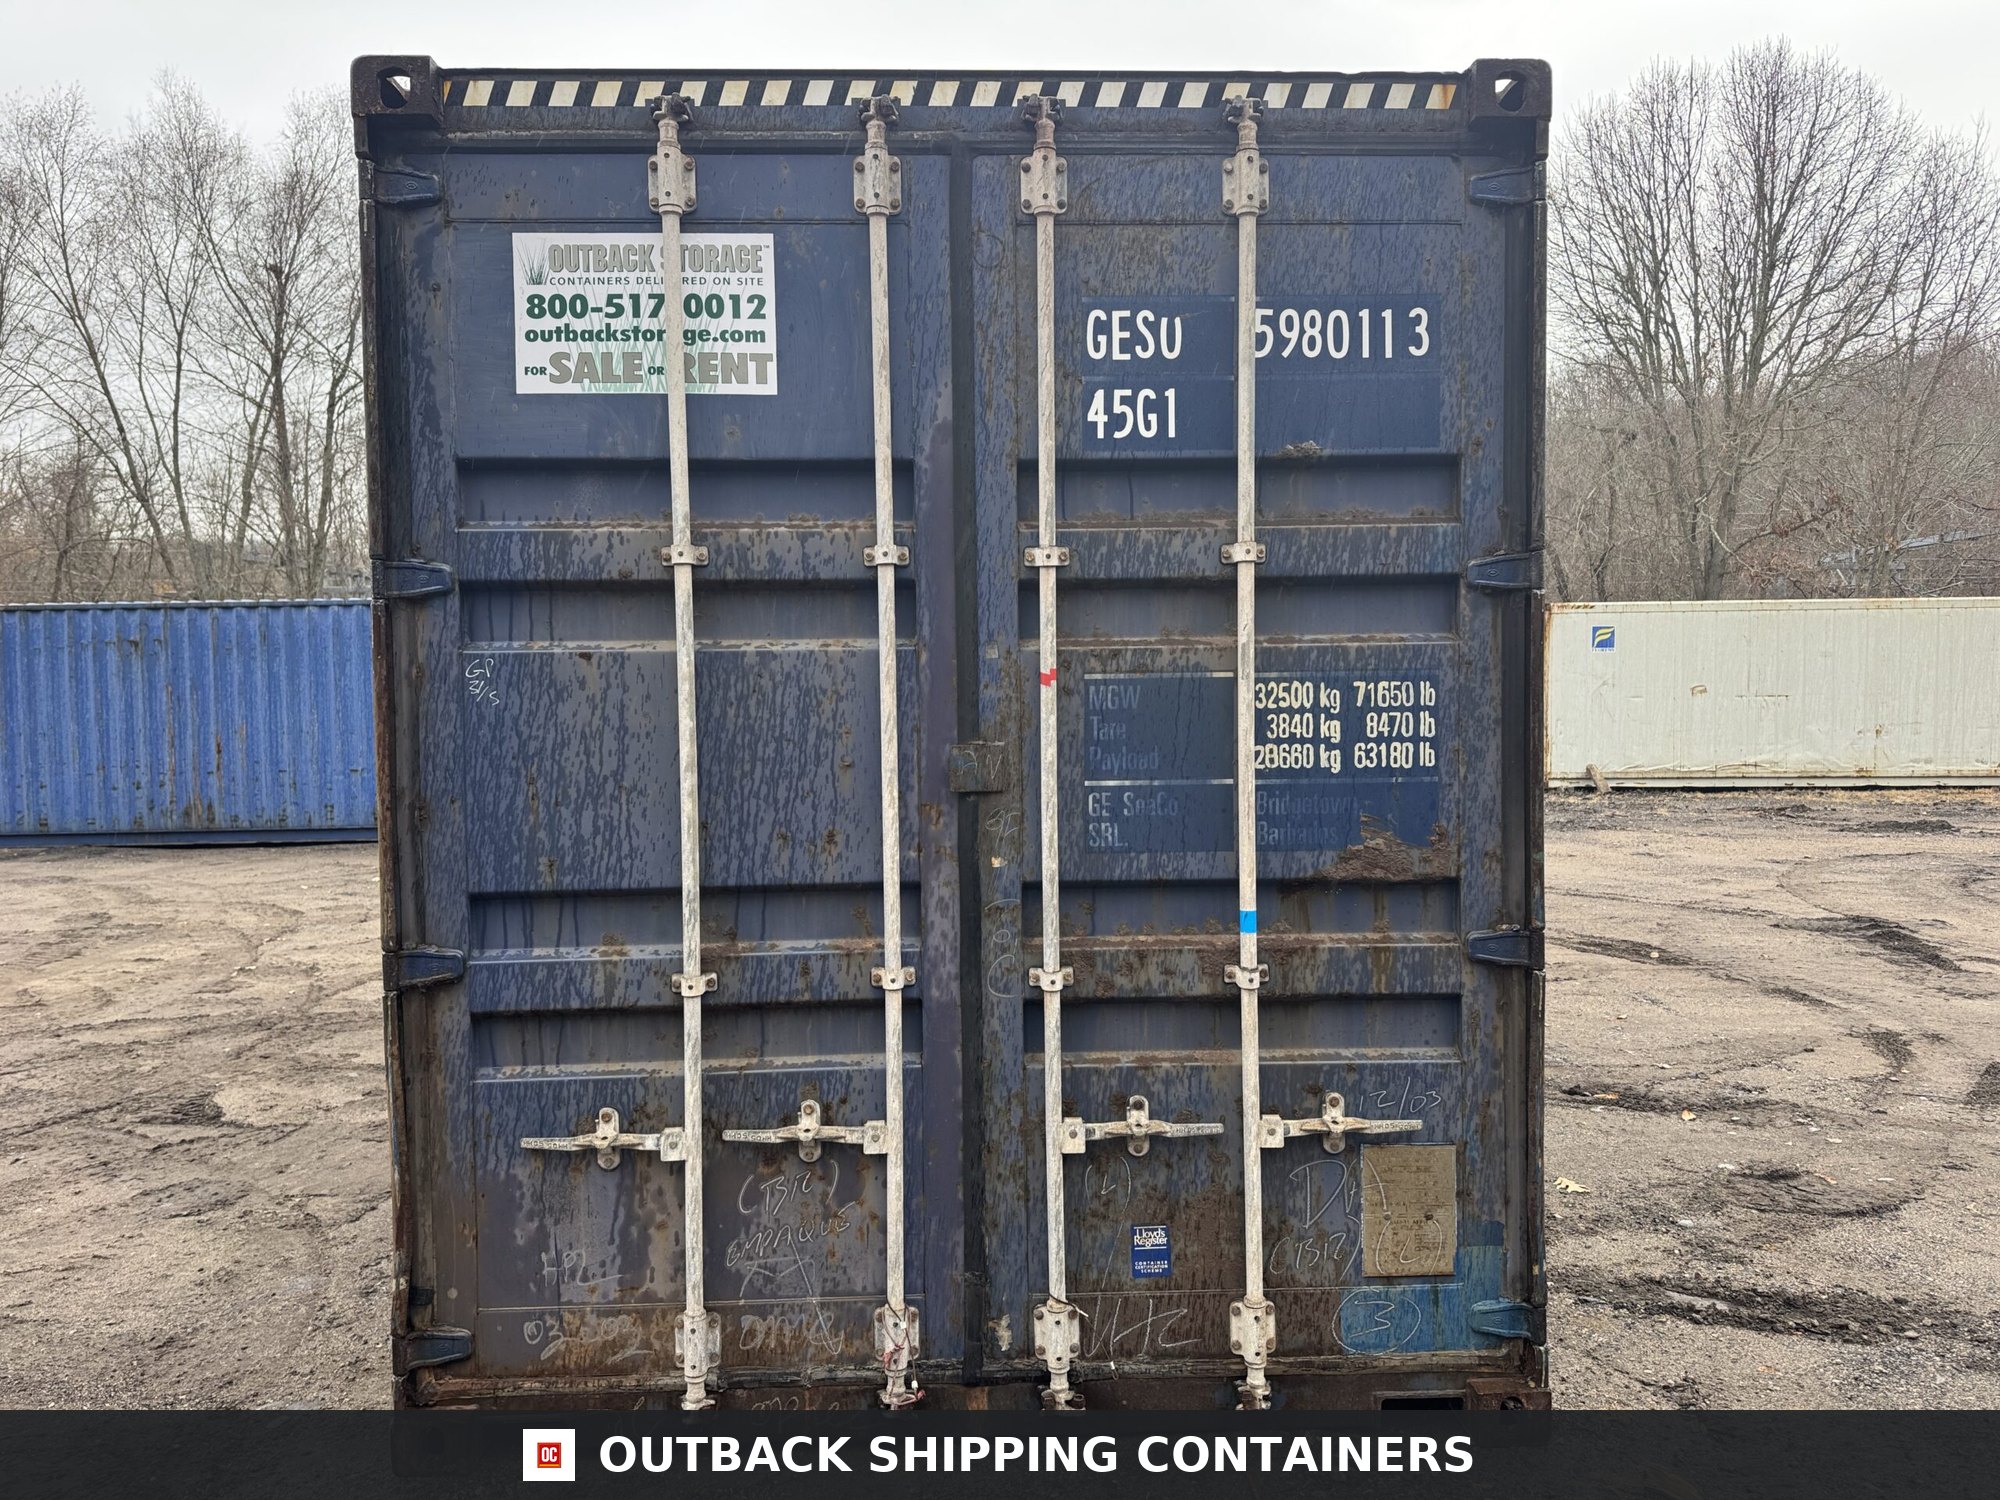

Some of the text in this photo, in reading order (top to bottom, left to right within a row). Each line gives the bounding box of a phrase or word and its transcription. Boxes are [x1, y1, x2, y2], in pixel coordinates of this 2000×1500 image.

[549, 244, 655, 272] OUTBACK
[549, 276, 764, 286] CONTAINERS DELIRED ON SITE
[526, 293, 767, 319] 800-5170012
[525, 323, 766, 346] outbackstorge.com
[1087, 309, 1182, 361] GESU
[524, 366, 547, 376] FOR
[549, 352, 643, 384] SALE
[648, 366, 665, 376] OR
[1087, 387, 1176, 439] 45G1
[1089, 681, 1436, 714] MGW 32500 kg 71650 lb
[1089, 711, 1436, 743] Tare 3840 kg 8470 lb
[1255, 743, 1315, 769] 28660
[1320, 744, 1341, 774] kg
[1354, 742, 1414, 768] 63180
[1420, 742, 1436, 767] lb
[1088, 792, 1112, 816] GE
[1134, 1235, 1168, 1247] Register
